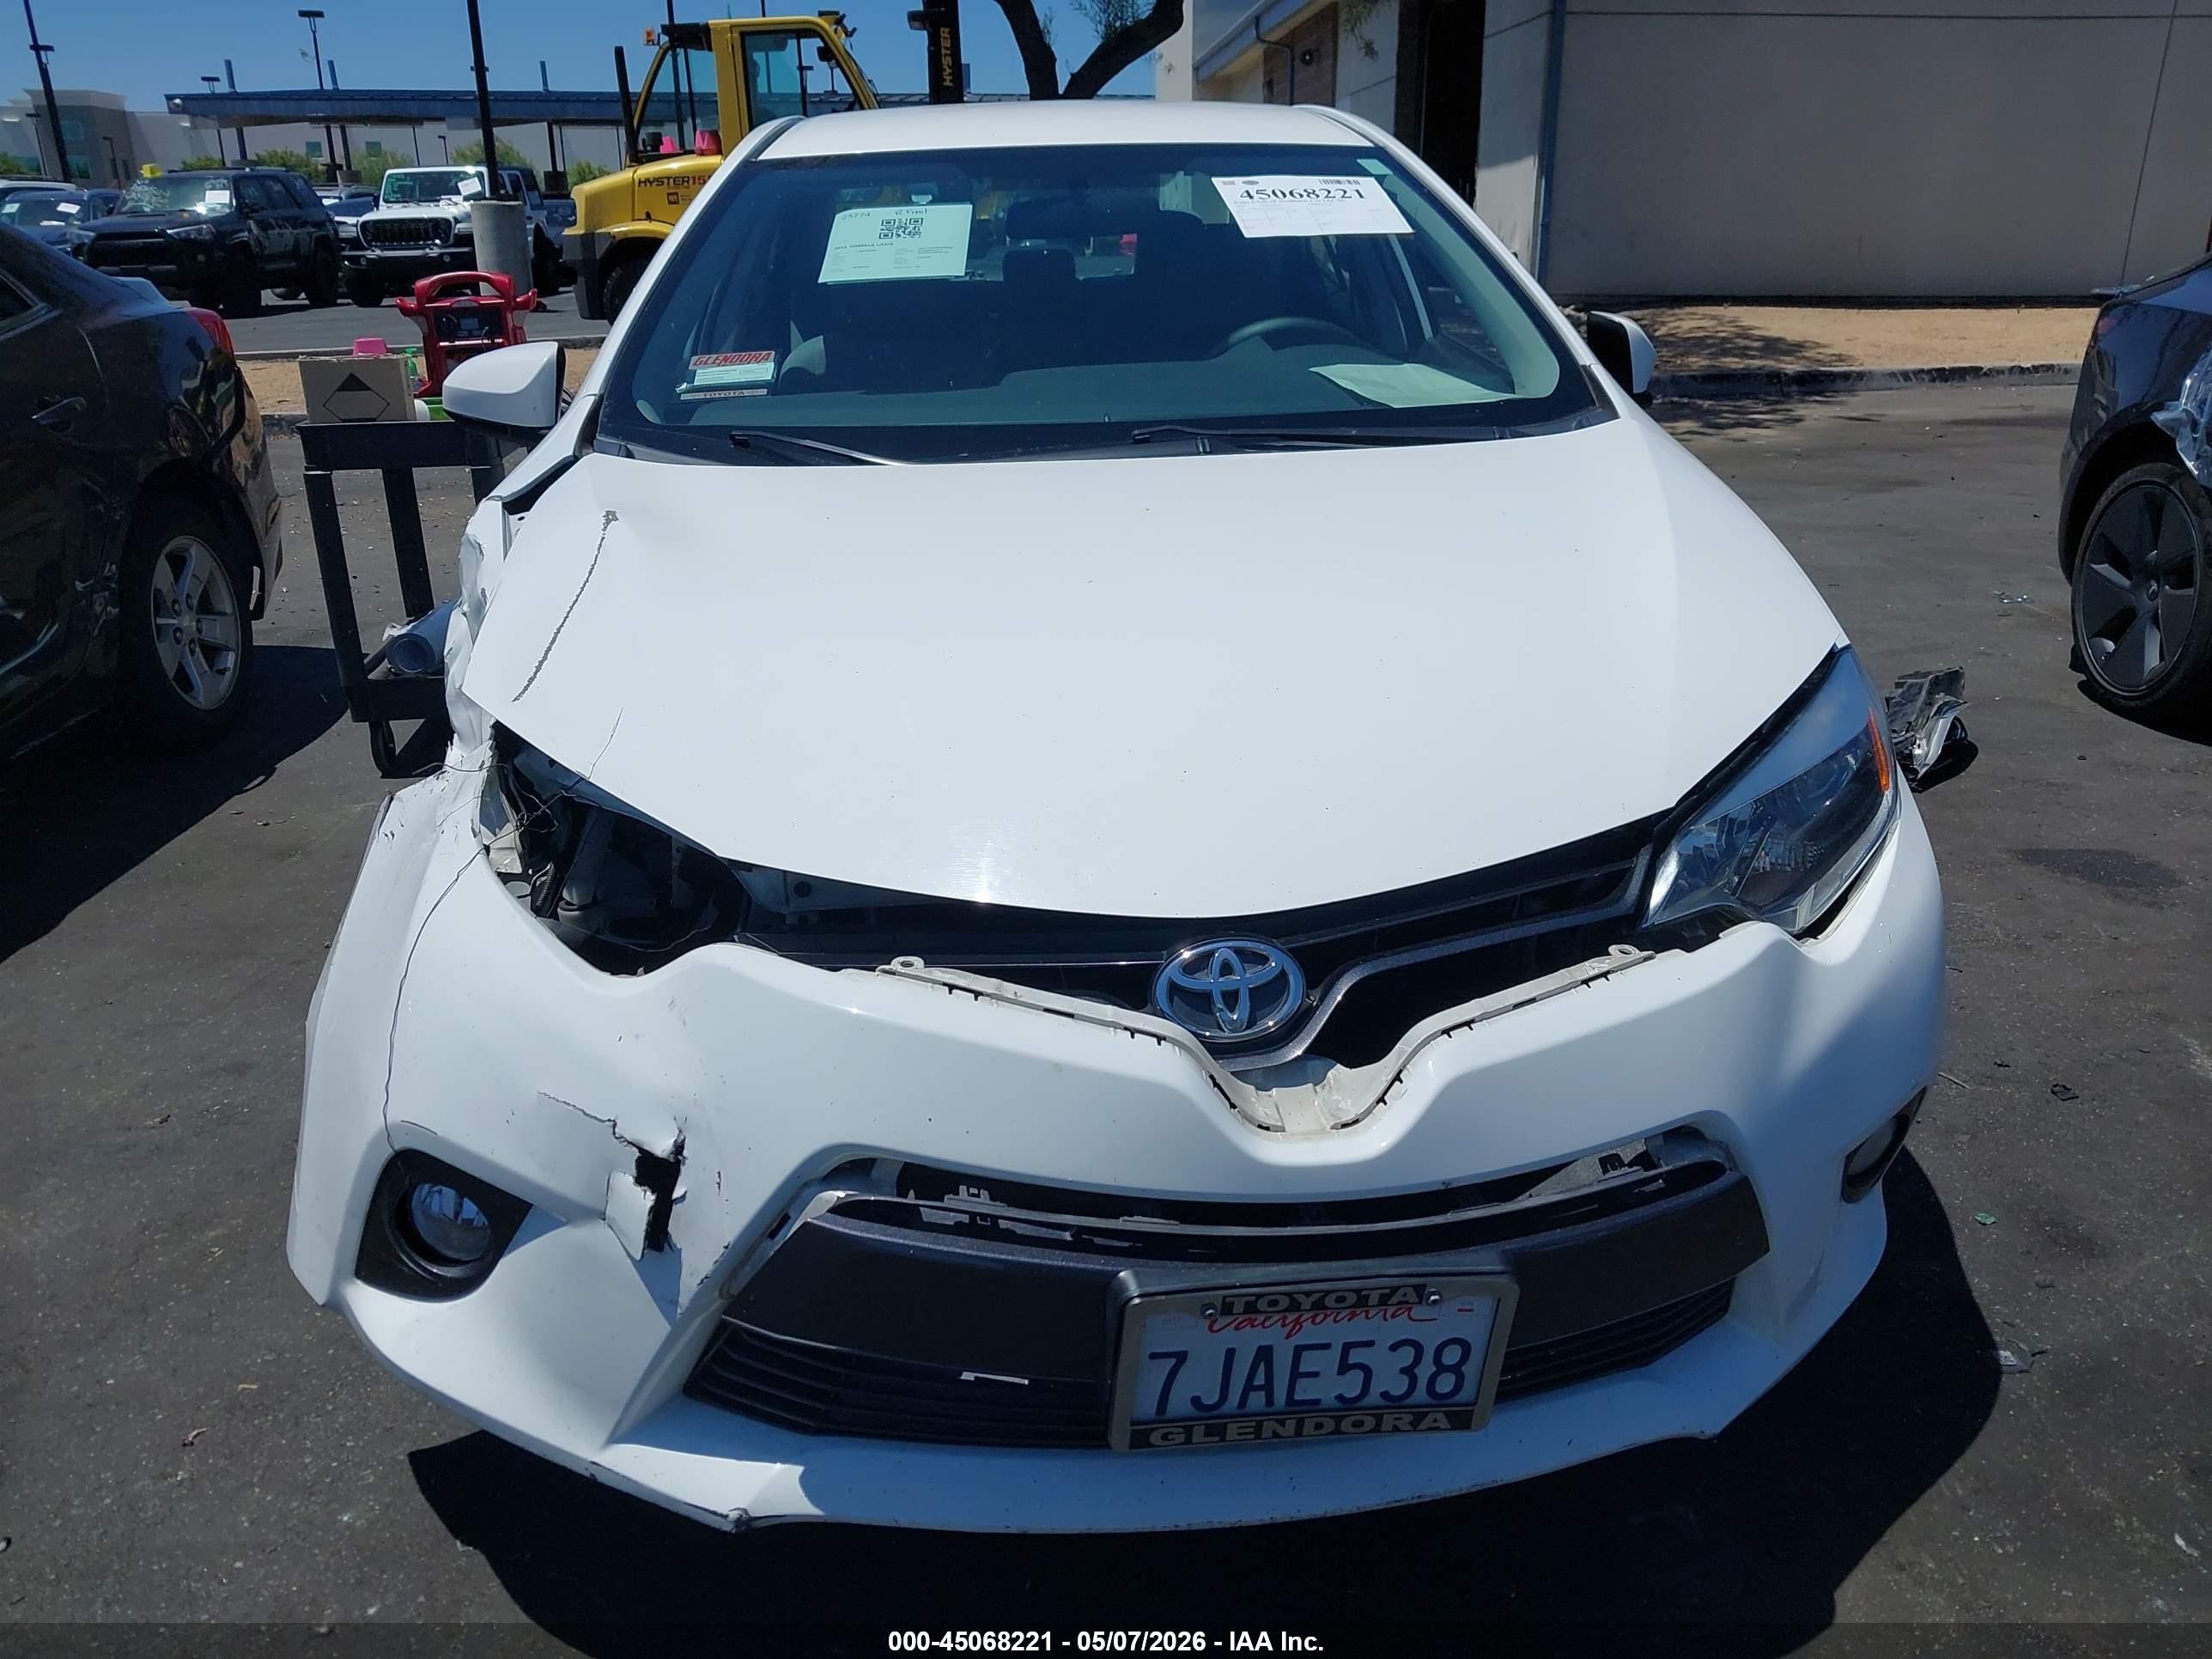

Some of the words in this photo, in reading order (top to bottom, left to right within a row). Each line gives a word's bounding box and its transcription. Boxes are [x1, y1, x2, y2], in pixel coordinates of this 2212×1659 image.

[940, 27, 953, 86] HYSTER
[1239, 188, 1366, 200] 45068221
[693, 351, 772, 366] GLENDORA
[1224, 1286, 1419, 1314] TOYOTA
[1148, 1337, 1472, 1416] 7JAE538
[1149, 1412, 1453, 1447] GLENDORA
